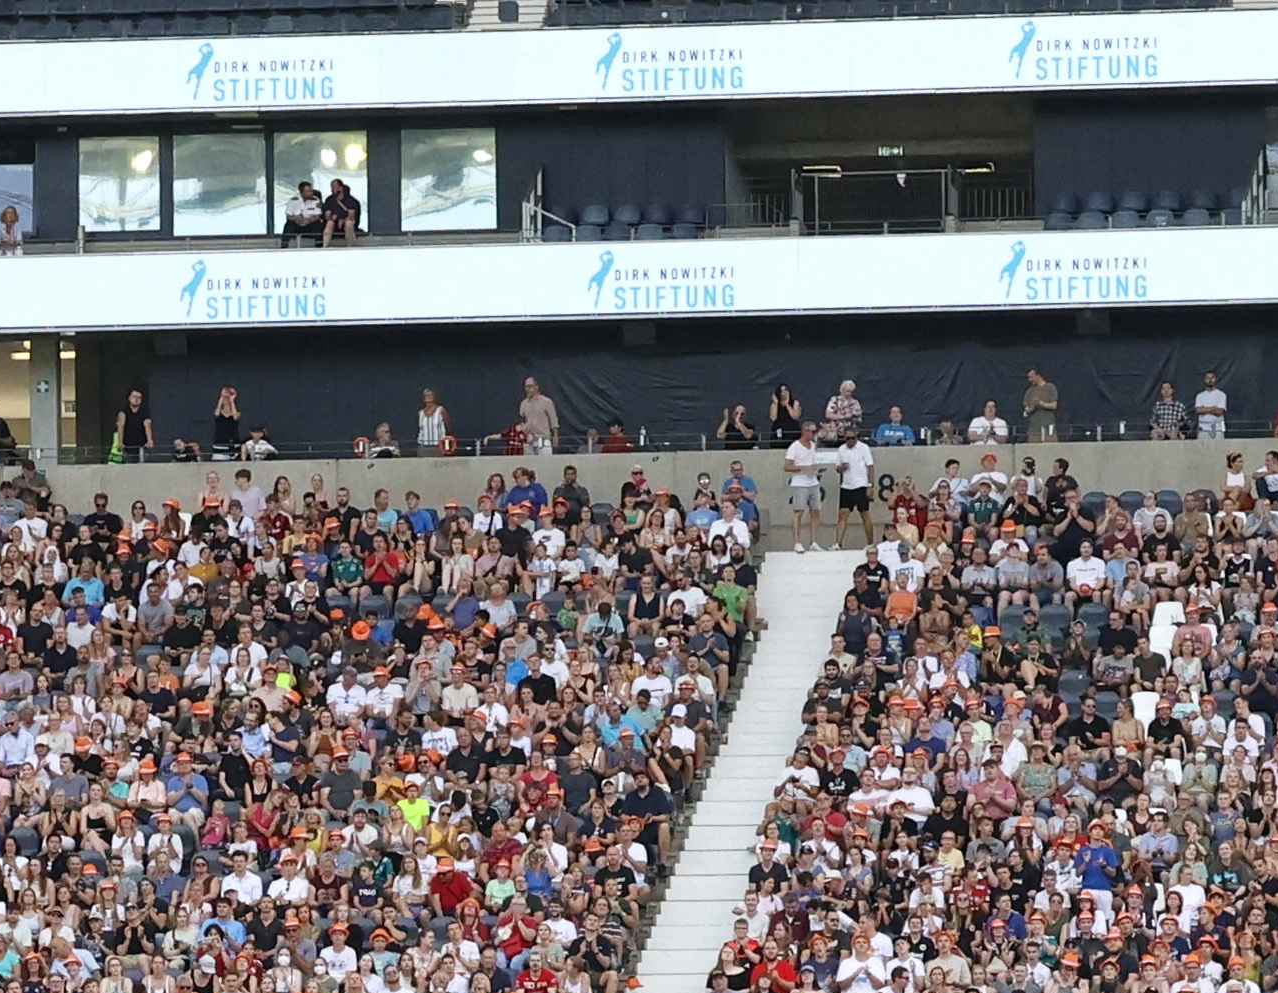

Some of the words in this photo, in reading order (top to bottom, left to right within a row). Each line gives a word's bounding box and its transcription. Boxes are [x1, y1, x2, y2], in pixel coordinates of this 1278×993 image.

[1036, 39, 1072, 52] DIRK
[1082, 36, 1157, 51] NOWITZKI
[214, 61, 249, 74] DIRK
[259, 59, 334, 73] NOWITZKI
[622, 51, 658, 64] DIRK
[668, 48, 743, 63] NOWITZKI
[1035, 53, 1158, 81] STIFTUNG
[213, 75, 334, 102] STIFTUNG
[621, 65, 743, 93] STIFTUNG
[614, 268, 650, 282] DIRK
[659, 266, 734, 281] NOWITZKI
[1026, 259, 1062, 272] DIRK
[1072, 257, 1147, 271] NOWITZKI
[206, 278, 242, 291] DIRK
[251, 276, 326, 290] NOWITZKI
[1025, 274, 1148, 301] STIFTUNG
[206, 293, 326, 320] STIFTUNG
[614, 283, 735, 311] STIFTUNG
